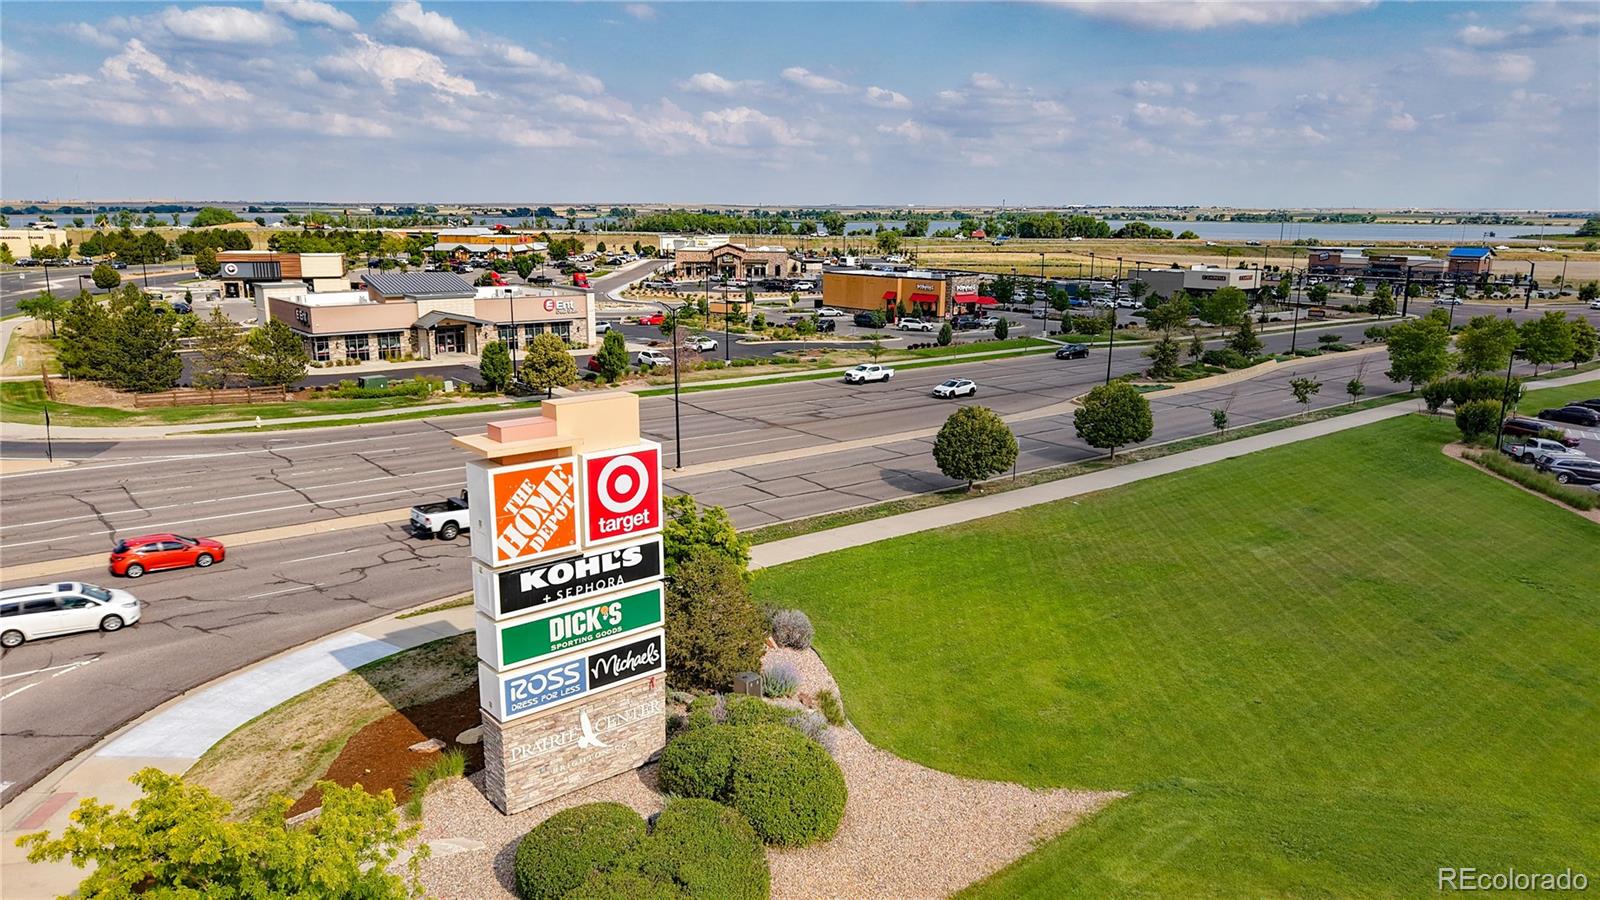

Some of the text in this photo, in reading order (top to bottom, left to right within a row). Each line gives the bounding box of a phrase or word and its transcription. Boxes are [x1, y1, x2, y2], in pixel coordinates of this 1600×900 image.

[497, 464, 574, 559] HOME
[503, 478, 536, 515] THE
[529, 493, 575, 552] DEPOT
[599, 508, 650, 532] target
[520, 546, 643, 592] KOHL'S
[556, 575, 625, 602] SEPHORA
[550, 602, 623, 642] DICK'S
[551, 626, 623, 651] SPORTING GOODS
[591, 642, 660, 680] Michaels
[510, 662, 580, 702] ROSS
[511, 684, 581, 711] DRESS FOR LESS
[510, 700, 661, 762] PRAIRIE CENTER
